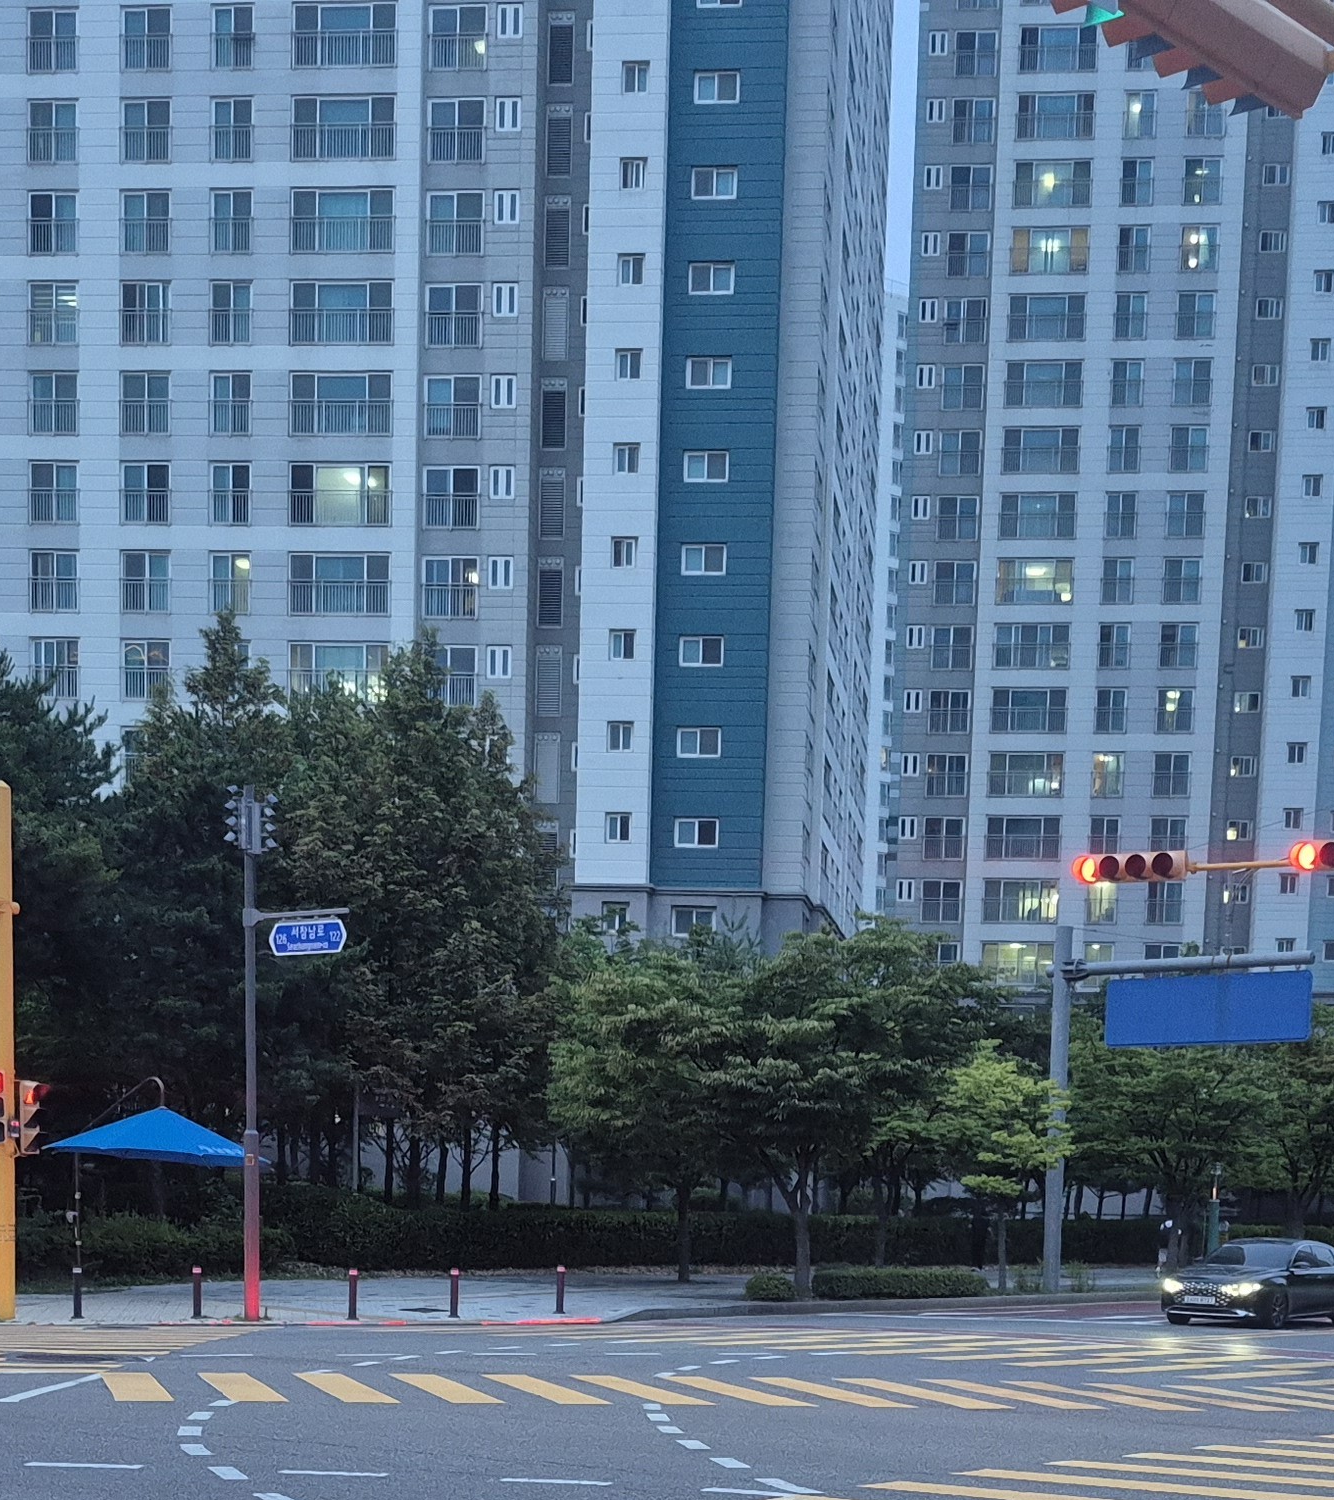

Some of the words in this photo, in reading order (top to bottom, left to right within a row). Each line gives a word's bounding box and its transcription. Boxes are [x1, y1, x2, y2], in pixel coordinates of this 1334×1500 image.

[291, 924, 325, 940] 서창남로
[329, 930, 341, 942] 122
[276, 933, 287, 945] 126
